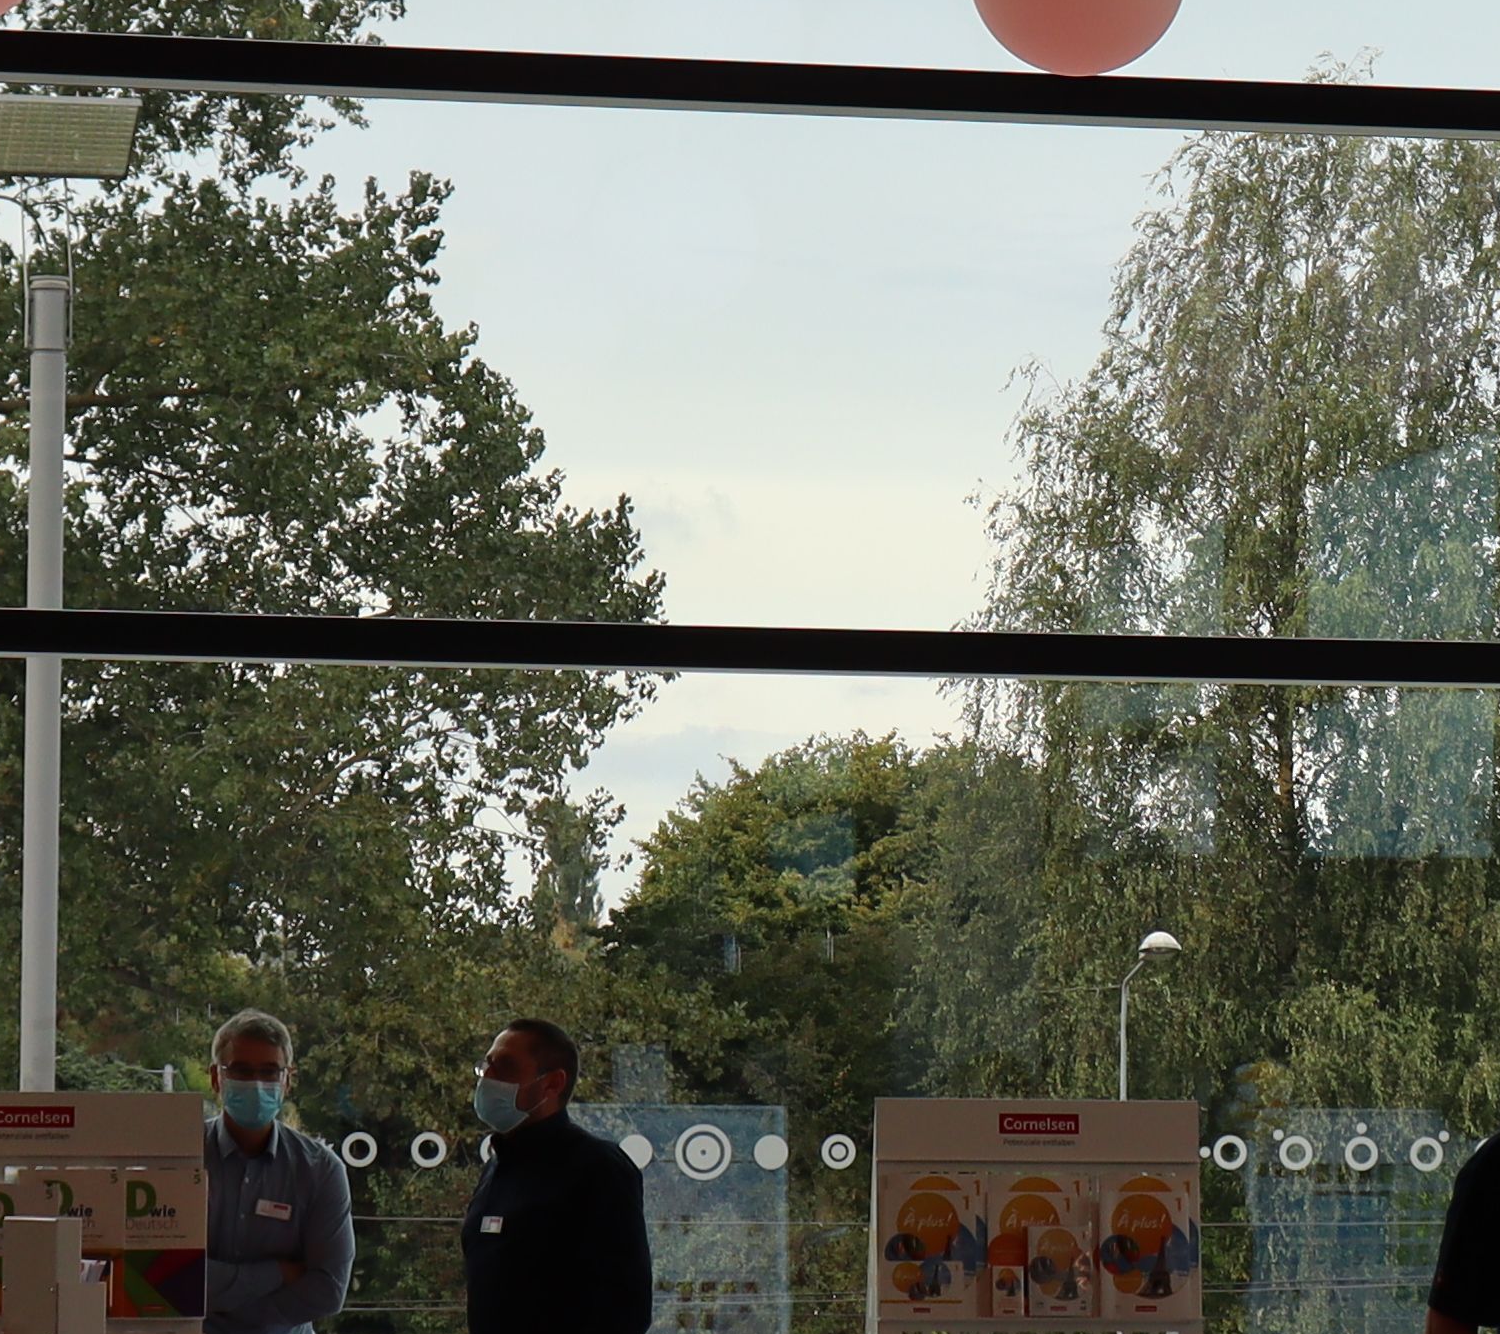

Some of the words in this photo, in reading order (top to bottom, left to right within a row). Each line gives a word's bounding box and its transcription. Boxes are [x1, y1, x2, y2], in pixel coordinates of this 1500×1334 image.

[1003, 1116, 1076, 1132] Cornelsen
[126, 1180, 157, 1217] D
[151, 1205, 176, 1218] wie
[67, 1205, 93, 1217] wie
[125, 1218, 179, 1230] Deutsch
